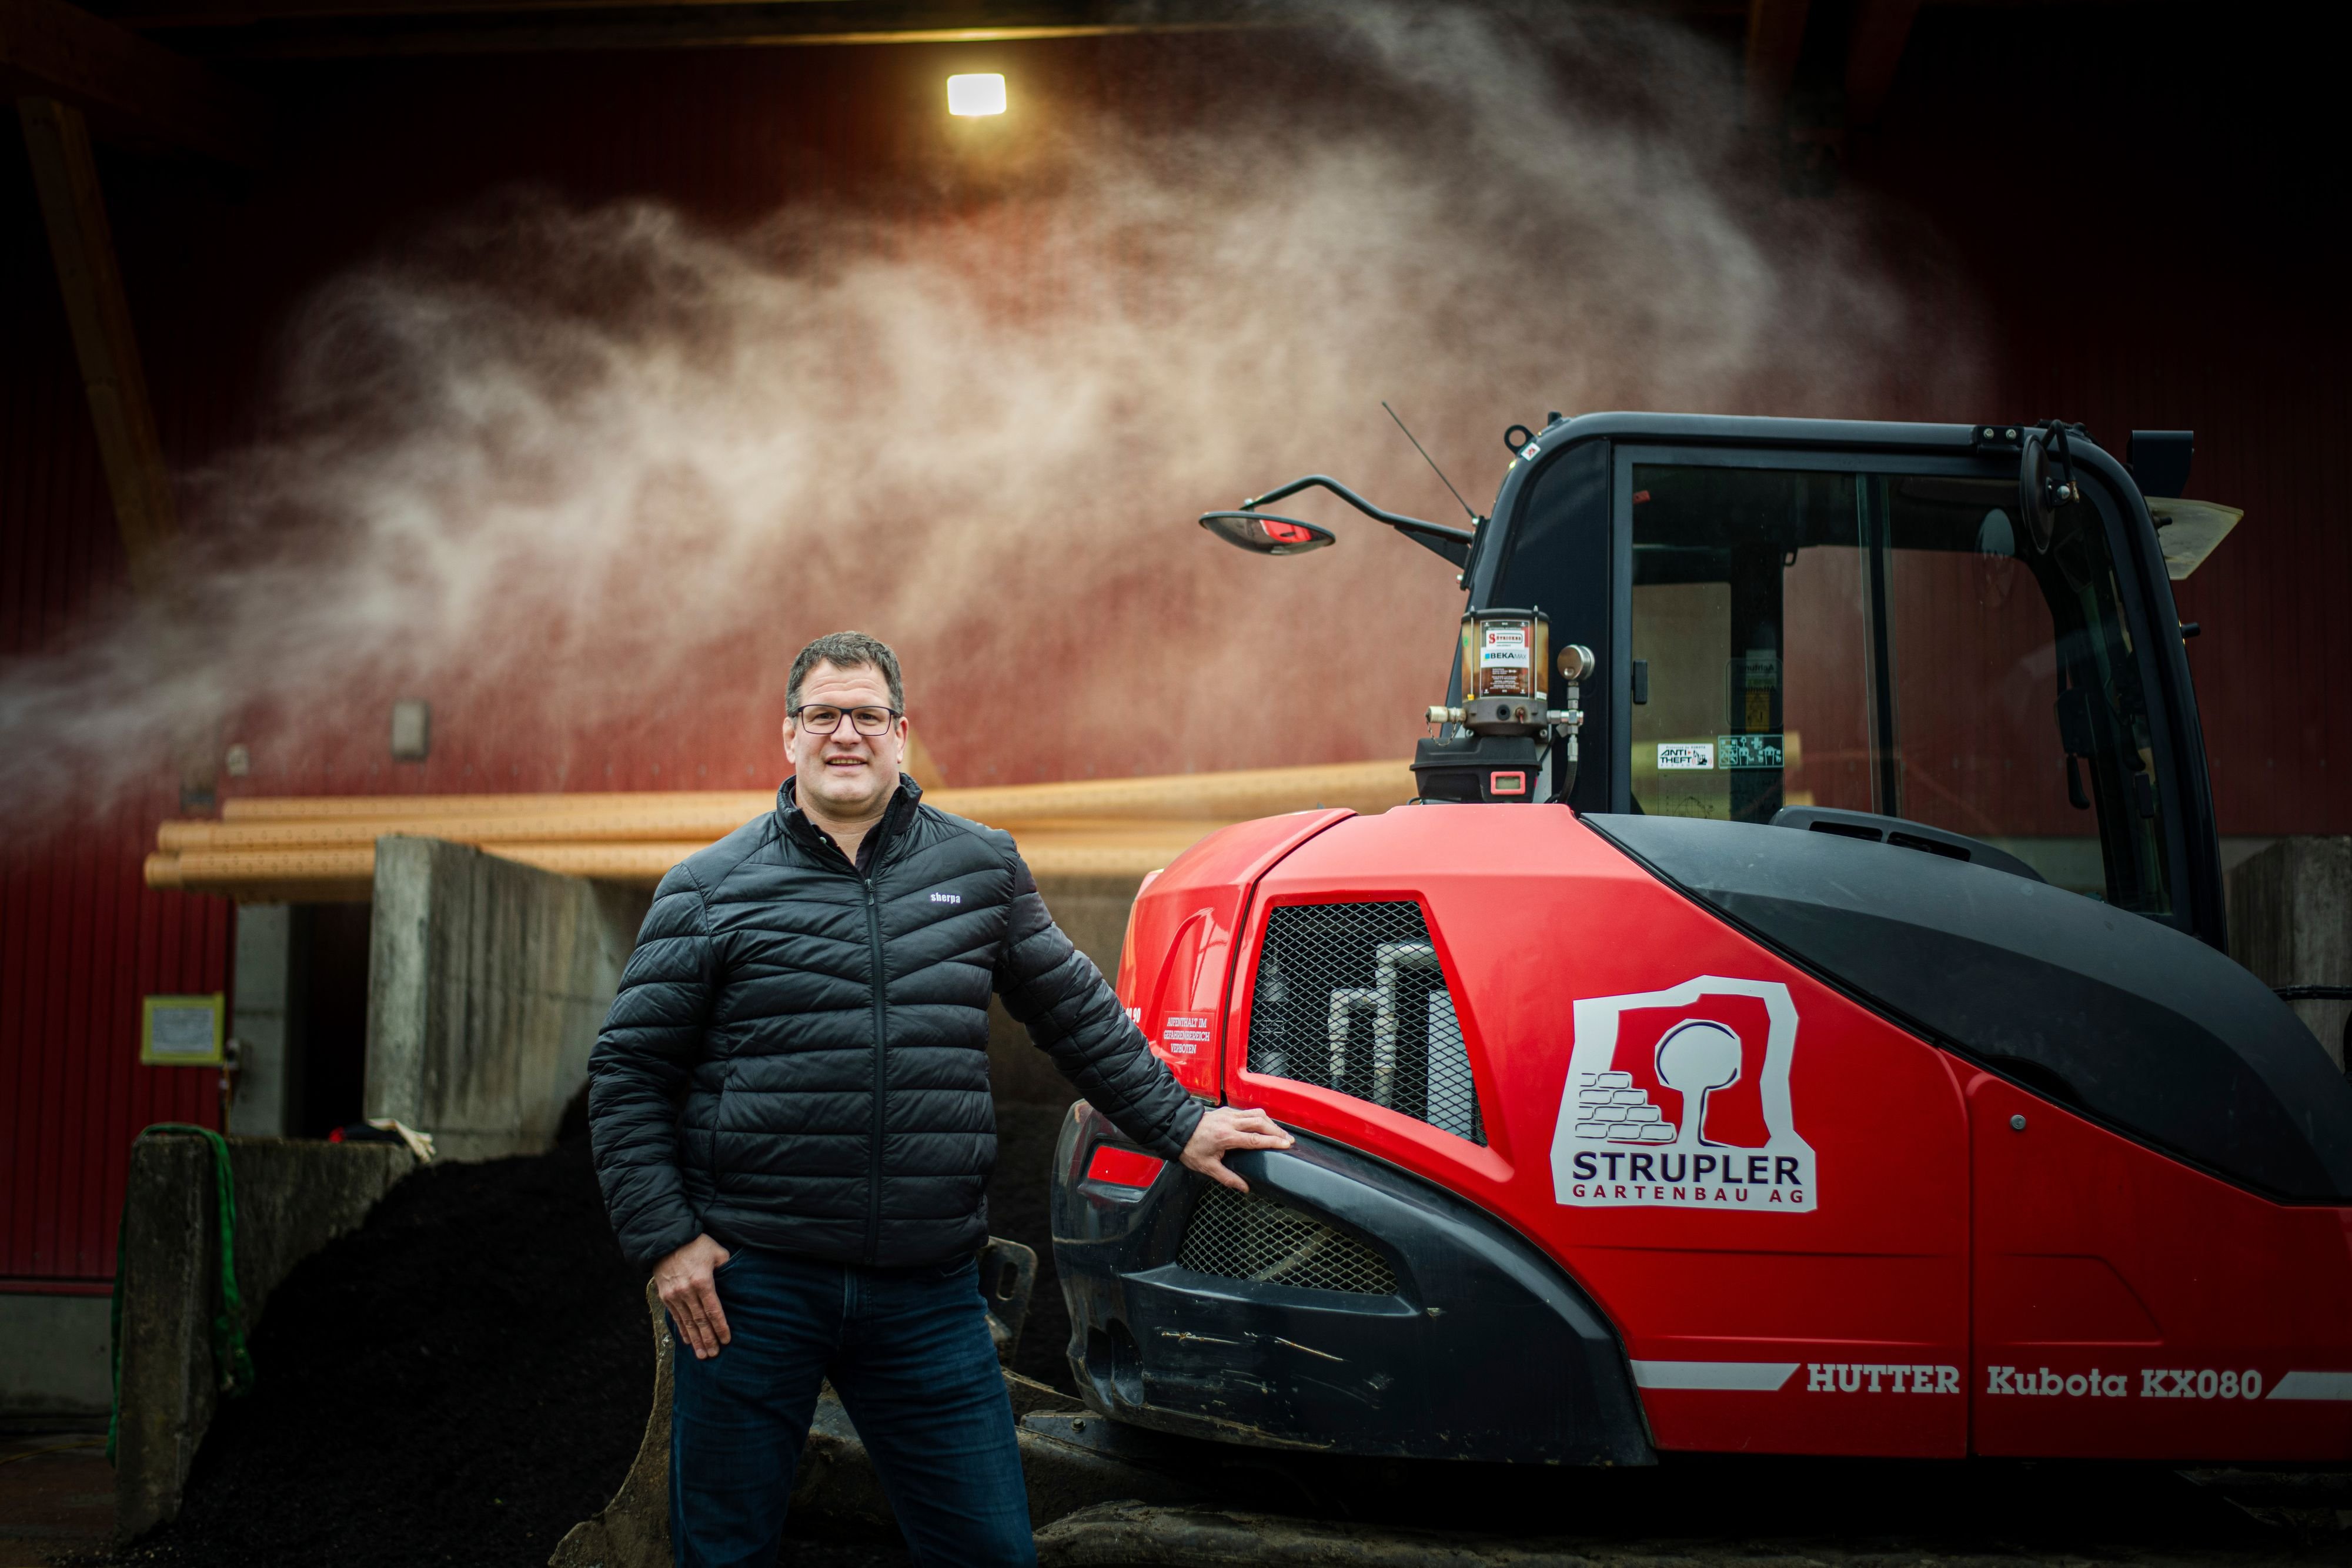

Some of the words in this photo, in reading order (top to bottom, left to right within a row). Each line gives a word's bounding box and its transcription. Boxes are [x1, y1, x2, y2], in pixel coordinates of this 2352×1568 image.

[931, 892, 960, 904] sherpa
[1167, 1017, 1198, 1028] AUFENTHALT
[1198, 1018, 1207, 1028] IM
[1164, 1030, 1210, 1041] GEFAHRENBEREICH
[1171, 1043, 1197, 1054] VERBOTEN
[1572, 1151, 1802, 1185] STRUPLER
[1572, 1184, 1748, 1202] GARTENBAU
[1769, 1189, 1803, 1203] AG
[1807, 1363, 1960, 1393] HUTTER
[1987, 1366, 2127, 1397] Kubota
[2140, 1369, 2263, 1400] KX080
